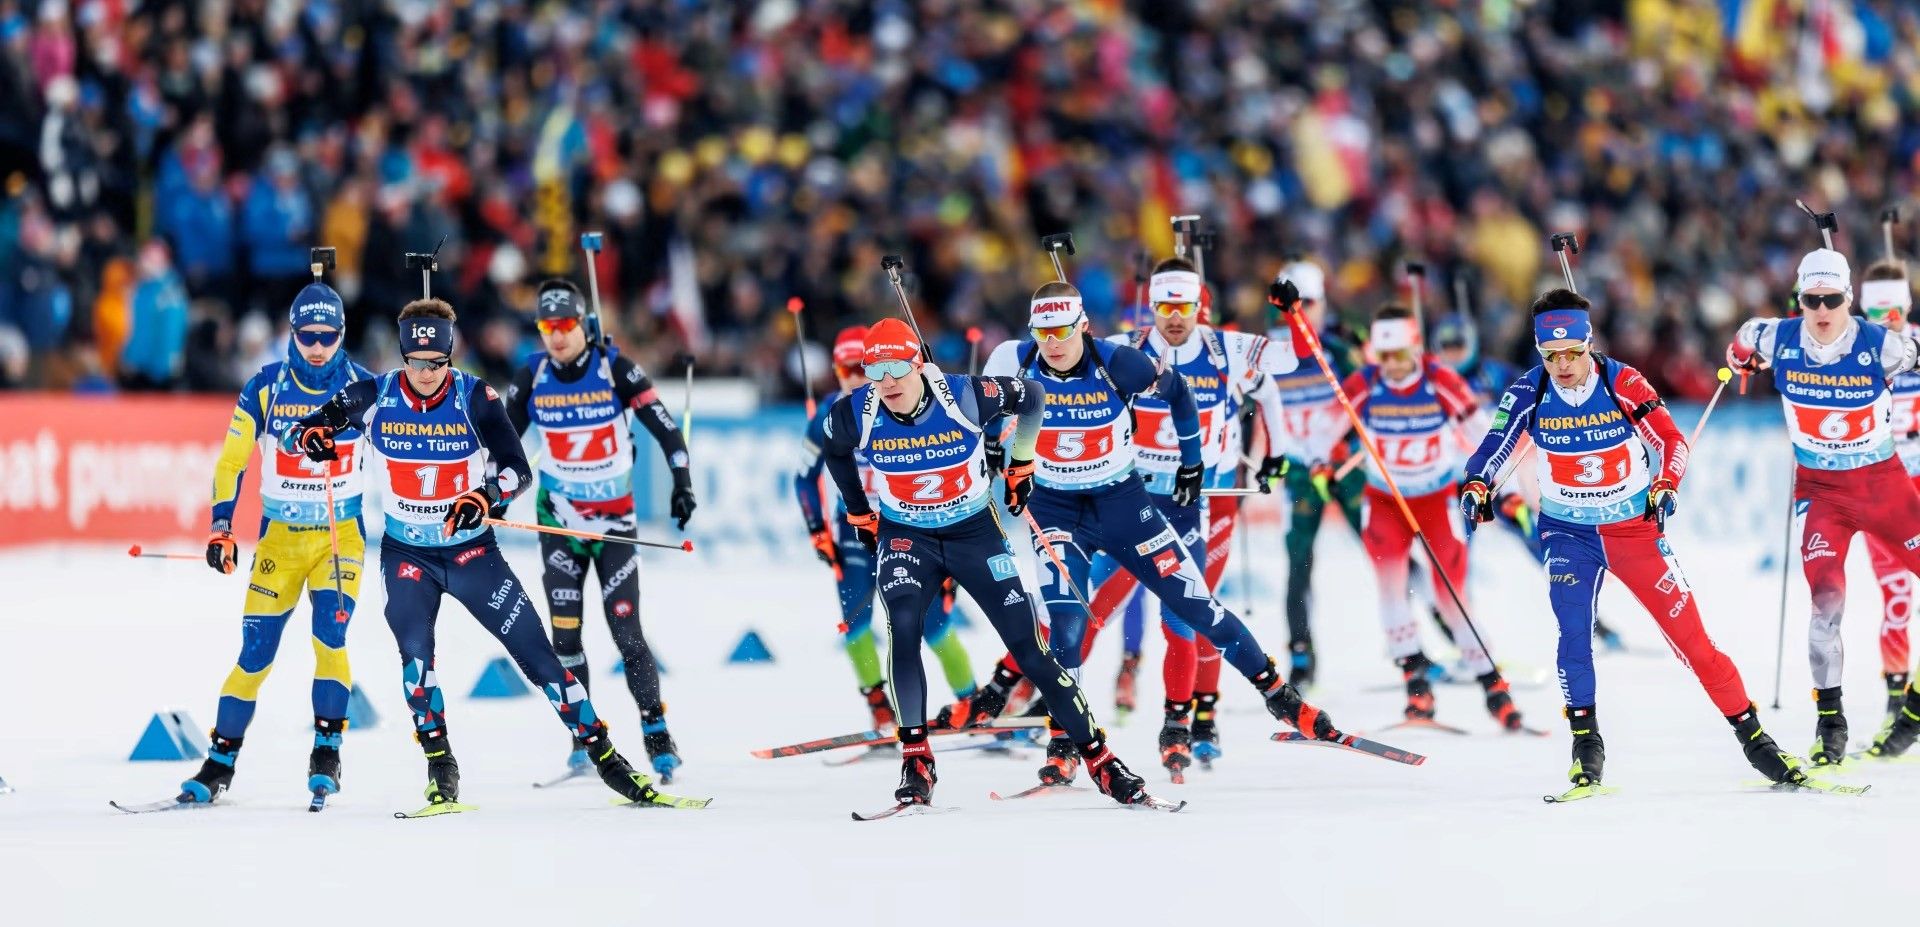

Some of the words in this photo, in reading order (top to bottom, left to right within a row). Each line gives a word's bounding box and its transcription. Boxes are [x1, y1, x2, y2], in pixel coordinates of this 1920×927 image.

[411, 323, 436, 339] ice
[1786, 370, 1872, 387] HÖRMANN
[934, 379, 955, 407] JOKA
[1786, 384, 1832, 399] Garage
[1835, 389, 1874, 399] Doors
[863, 387, 876, 416] JOKA
[536, 410, 564, 422] Tore
[575, 405, 615, 420] Türen
[1067, 407, 1112, 420] Türen
[1539, 410, 1622, 430] HÖRMANN
[381, 421, 467, 436] HÖRMANN
[1819, 411, 1850, 440] 6
[1860, 416, 1871, 433] 1
[872, 430, 964, 451] HÖRMANN
[1540, 432, 1570, 444] Tore
[1583, 426, 1625, 441] Türen
[381, 437, 412, 451] Tore
[427, 439, 469, 452] Türen
[566, 432, 594, 460] 7
[601, 436, 613, 456] 1
[1054, 431, 1085, 460] 5
[1098, 436, 1109, 454] 1
[873, 453, 922, 464] Garage
[925, 444, 967, 460] Doors
[1138, 450, 1181, 462] ÖSTERS
[1574, 455, 1605, 485] 3
[1616, 459, 1626, 479] 1
[415, 465, 440, 497] 1
[453, 474, 465, 492] 1
[913, 473, 944, 500] 2
[398, 500, 453, 514] ÖSTERSU
[1149, 533, 1172, 549] STARK
[458, 548, 483, 563] MENY
[883, 576, 922, 592] tectake
[1003, 596, 1024, 606] adidas
[501, 597, 525, 635] CRAFT
